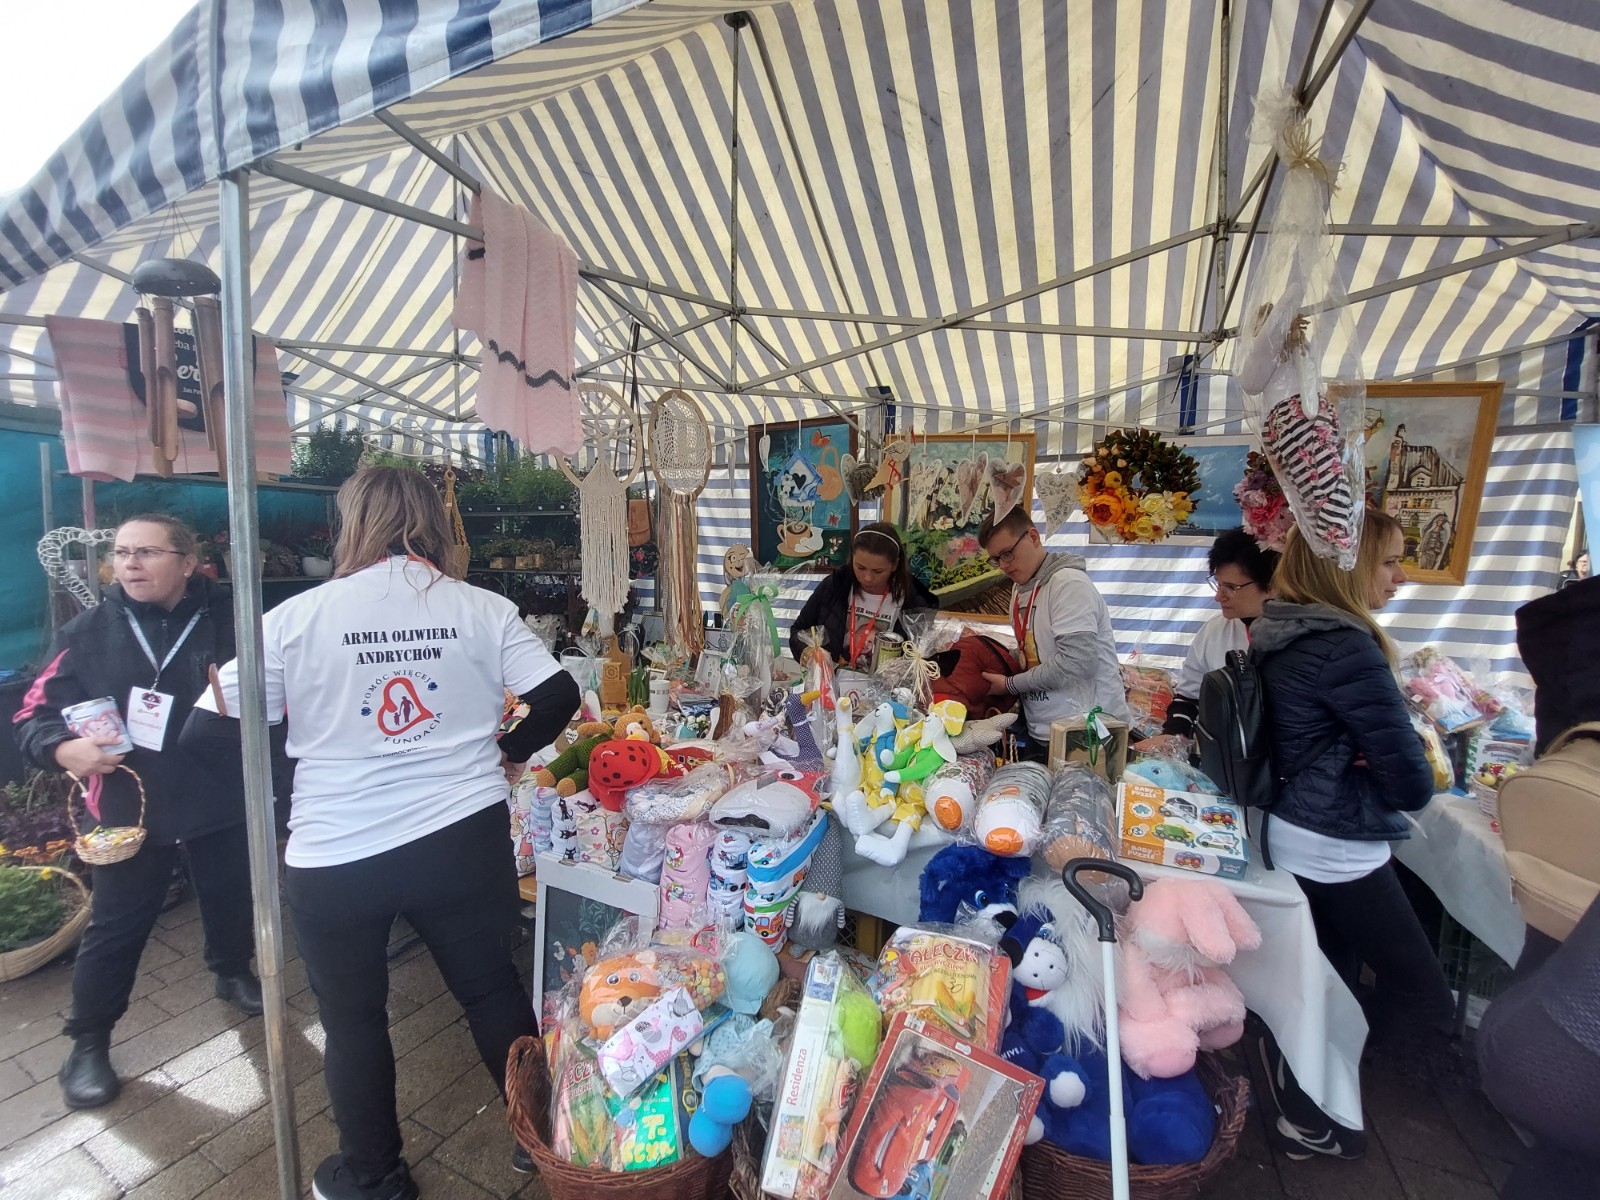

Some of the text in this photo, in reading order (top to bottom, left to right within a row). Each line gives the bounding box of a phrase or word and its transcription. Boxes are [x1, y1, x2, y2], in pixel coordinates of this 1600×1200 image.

[341, 627, 458, 646] ARMIA OLIWIERA
[356, 645, 443, 665] ANDRYCHÓW
[362, 669, 432, 705] POMÓC WIĘCEJ
[1029, 690, 1050, 702] SMA
[384, 711, 443, 745] FUNDACJA
[909, 943, 979, 963] AŁECZK
[1000, 1046, 1026, 1059] NIVEA
[785, 1048, 807, 1106] Residenza
